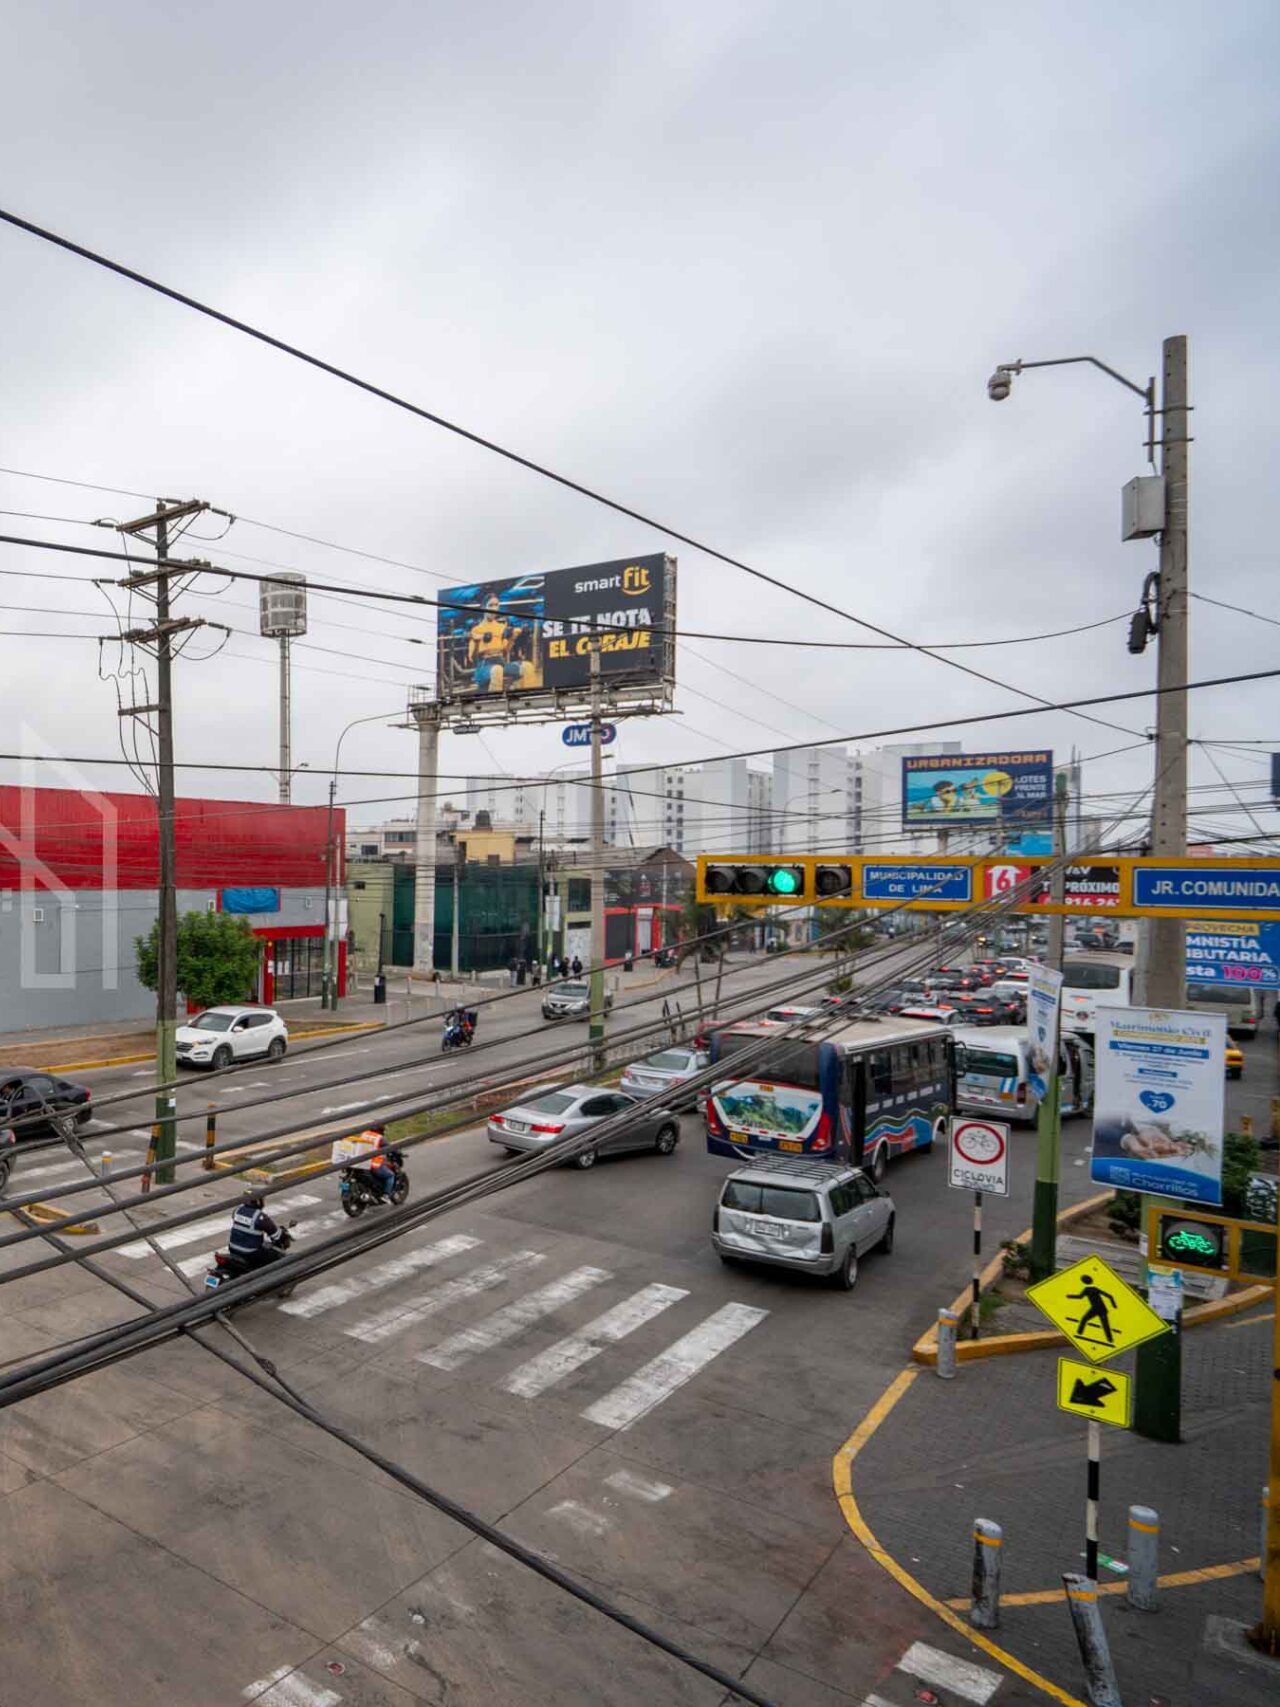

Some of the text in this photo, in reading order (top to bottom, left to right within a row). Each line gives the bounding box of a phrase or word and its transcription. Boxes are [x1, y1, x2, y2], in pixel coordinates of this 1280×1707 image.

[575, 566, 650, 593] smart fit
[542, 607, 652, 638] SE TE NOTA
[549, 631, 652, 658] EL CRAJE
[906, 753, 1048, 769] URBANIZADORA
[1015, 775, 1048, 784] LOTES
[869, 870, 964, 881] MUNICIPALIDAD
[996, 868, 1011, 891] 6
[888, 883, 943, 894] DE LIMA
[1065, 878, 1120, 894] PRÓXIMO
[1150, 880, 1180, 895] JR.
[1186, 935, 1261, 950] MNISTÍA
[1186, 948, 1273, 963] IBUTARIA
[1186, 964, 1277, 982] sta 100%
[953, 1168, 1004, 1186] CICLOVIA
[1131, 1177, 1200, 1197] Chorrillos
